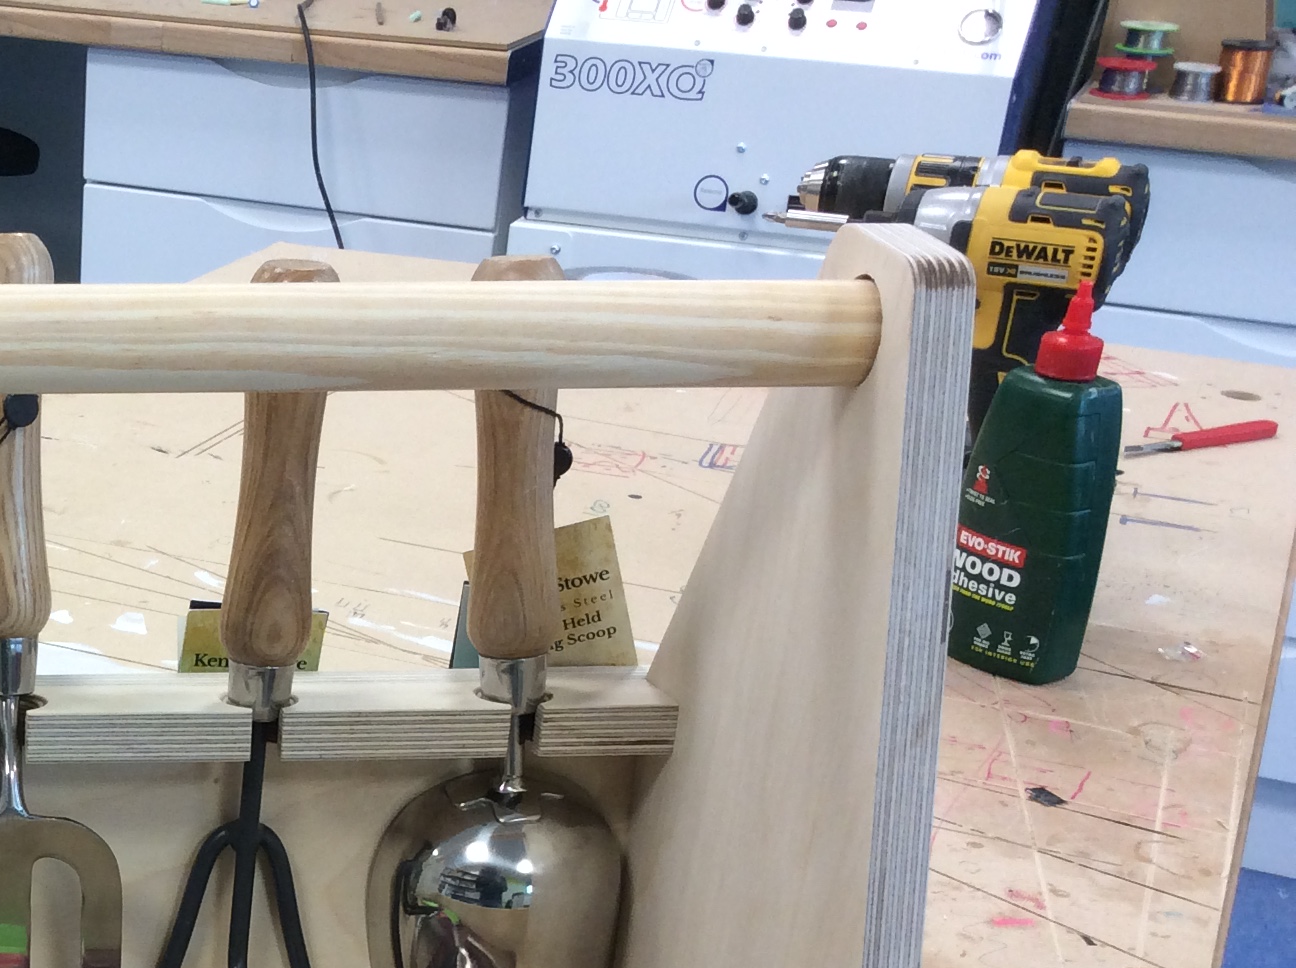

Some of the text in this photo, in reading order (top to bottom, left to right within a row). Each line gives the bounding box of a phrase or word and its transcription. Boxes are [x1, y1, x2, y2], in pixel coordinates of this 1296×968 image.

[952, 568, 1017, 605] dhesive
[573, 589, 615, 609] Steel
[562, 610, 602, 631] Held
[566, 625, 618, 646] Scoop
[194, 653, 229, 669] Ken
